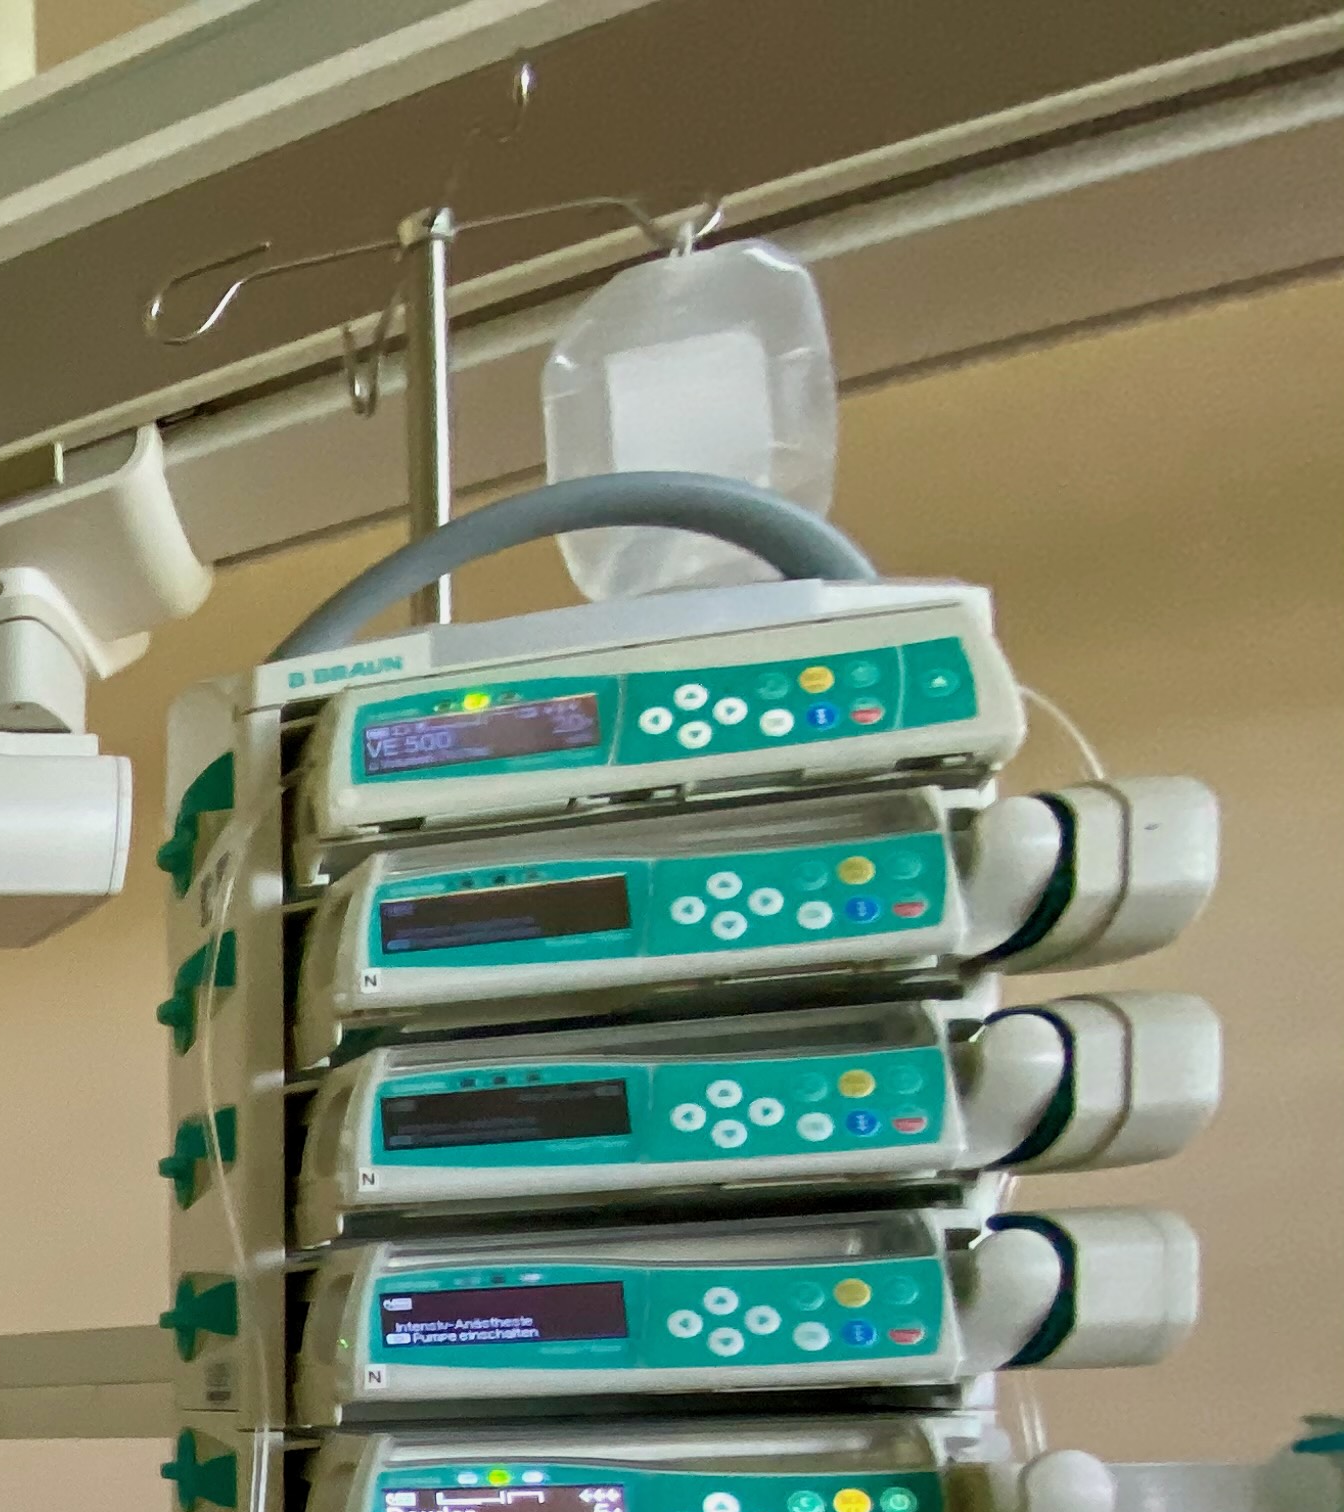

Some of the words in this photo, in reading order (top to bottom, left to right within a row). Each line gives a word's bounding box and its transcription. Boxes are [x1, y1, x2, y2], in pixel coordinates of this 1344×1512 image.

[313, 656, 404, 684] BRAUN
[366, 736, 400, 758] VE
[403, 731, 452, 753] 500
[364, 975, 377, 987] N
[362, 1172, 375, 1185] N
[368, 1370, 382, 1384] N
